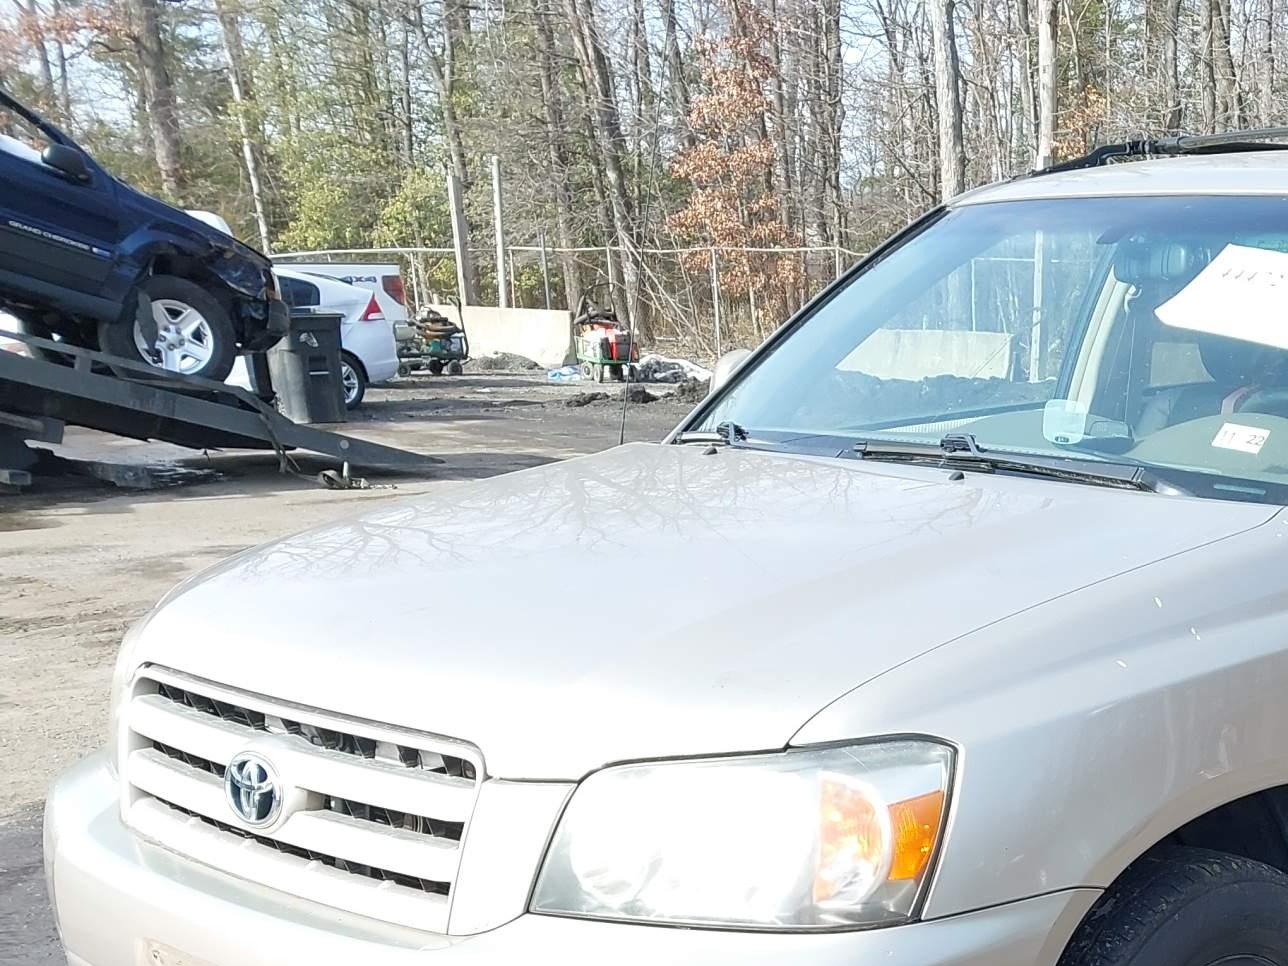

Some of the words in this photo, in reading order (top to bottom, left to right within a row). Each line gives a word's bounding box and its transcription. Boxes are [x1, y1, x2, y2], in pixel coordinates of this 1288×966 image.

[8, 220, 42, 235] GRAND
[42, 231, 90, 250] CHEROKEE
[1246, 434, 1265, 447] 22
